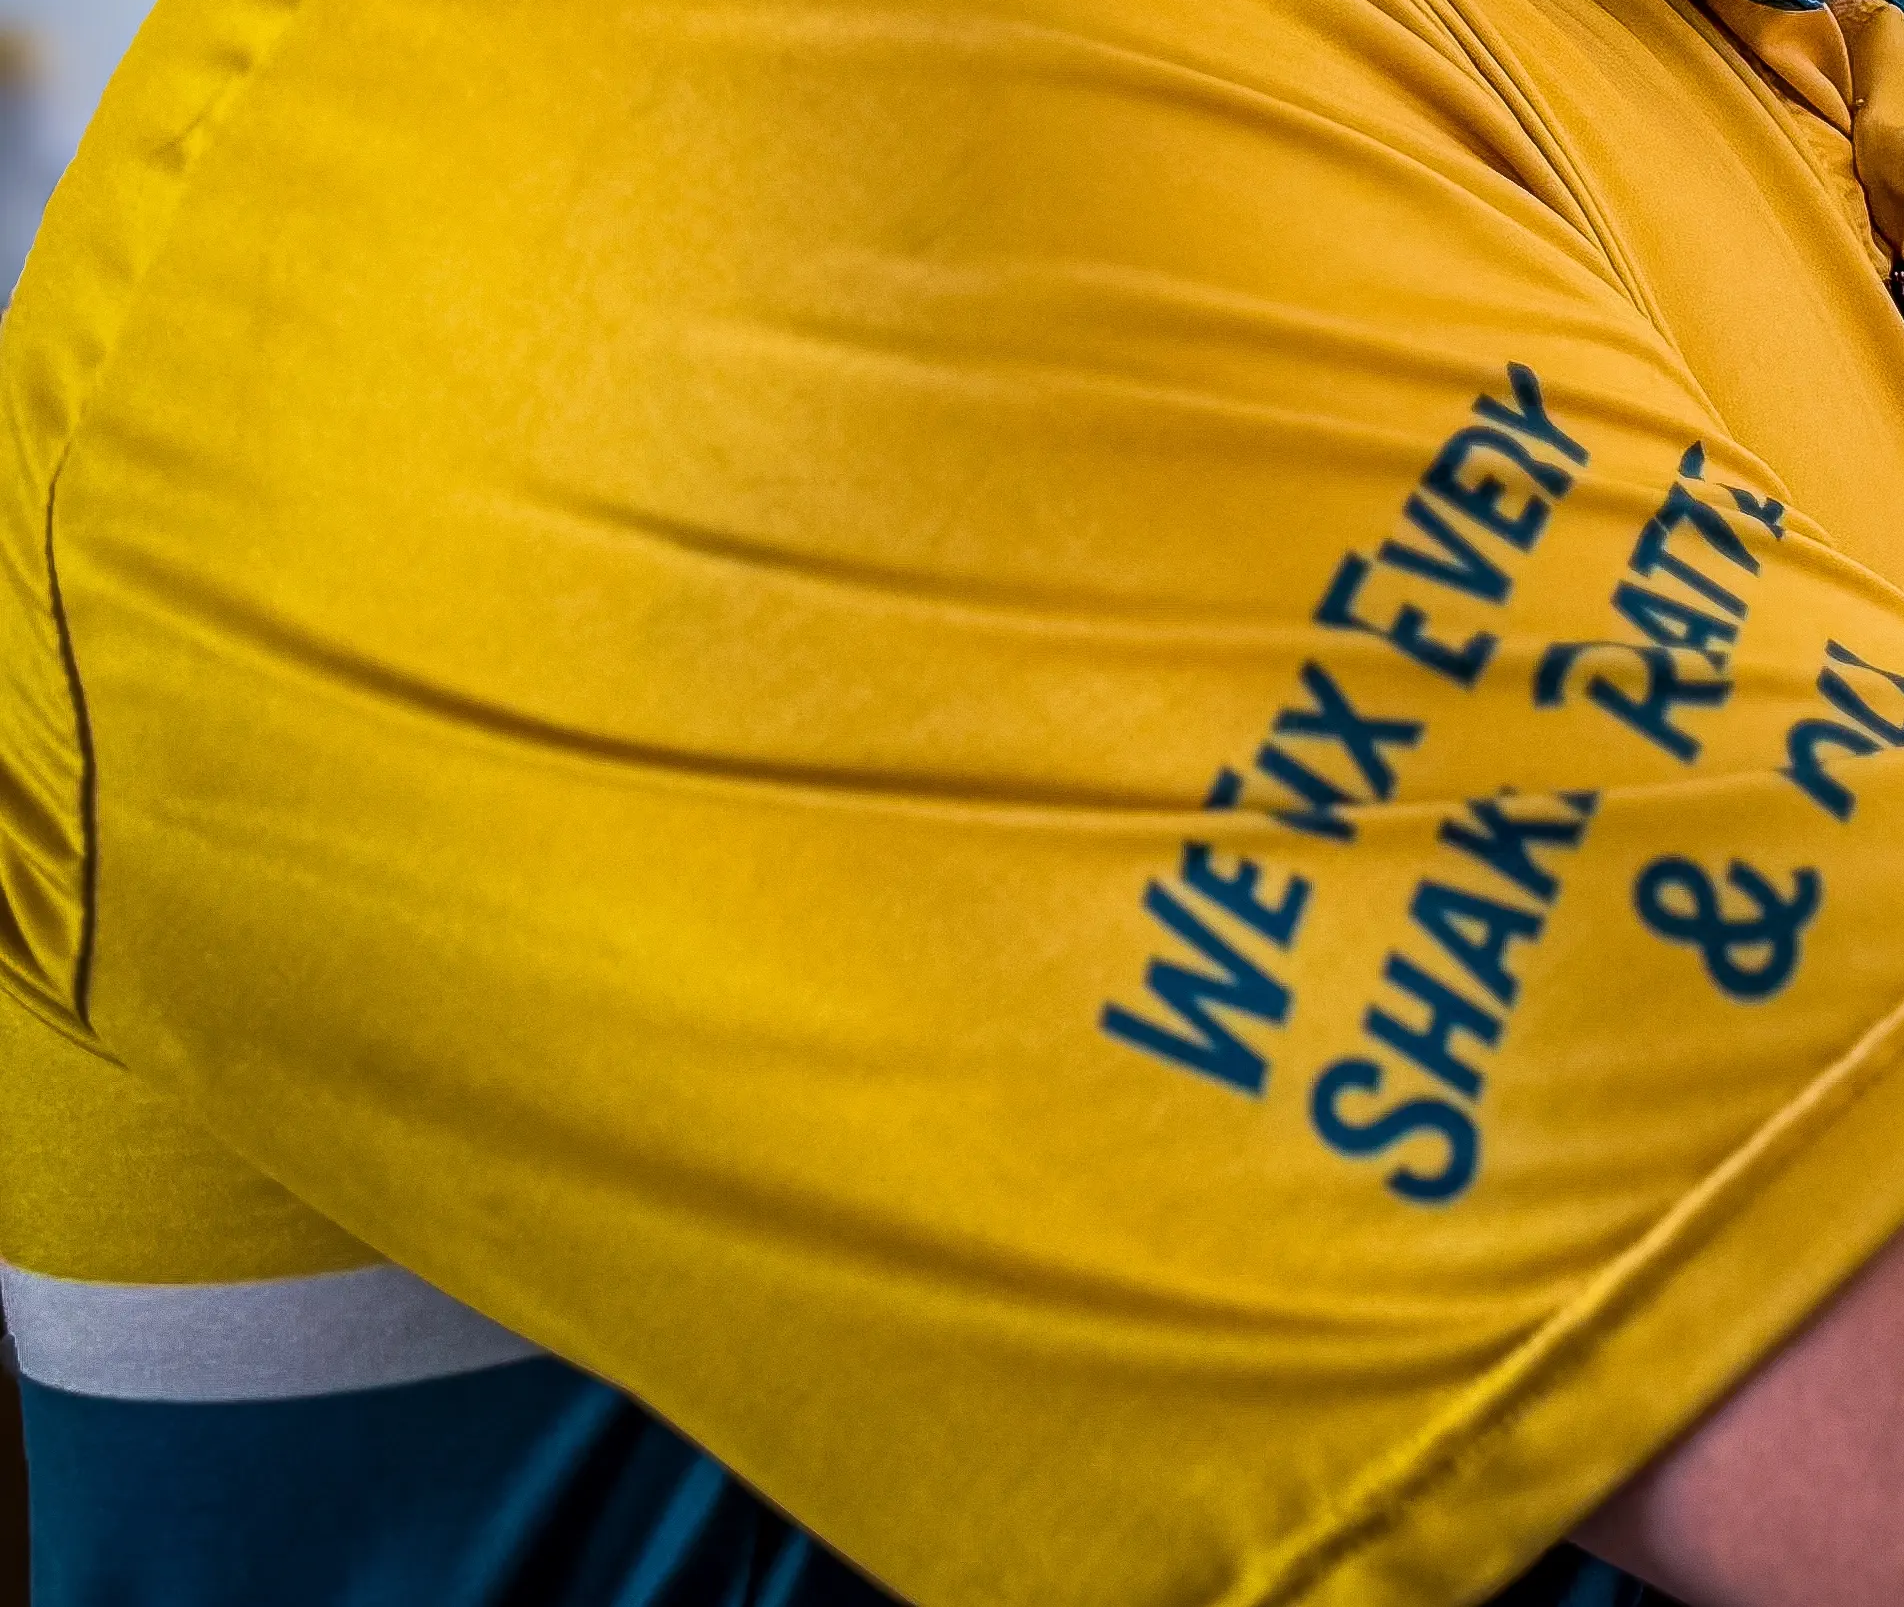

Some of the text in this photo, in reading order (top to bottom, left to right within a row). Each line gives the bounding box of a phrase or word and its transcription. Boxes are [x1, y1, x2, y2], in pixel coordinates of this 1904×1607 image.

[1098, 839, 1312, 1100] WE
[1312, 360, 1591, 691] EVERY
[1631, 854, 1823, 1004] &
[1307, 784, 1603, 1205] SHAK
